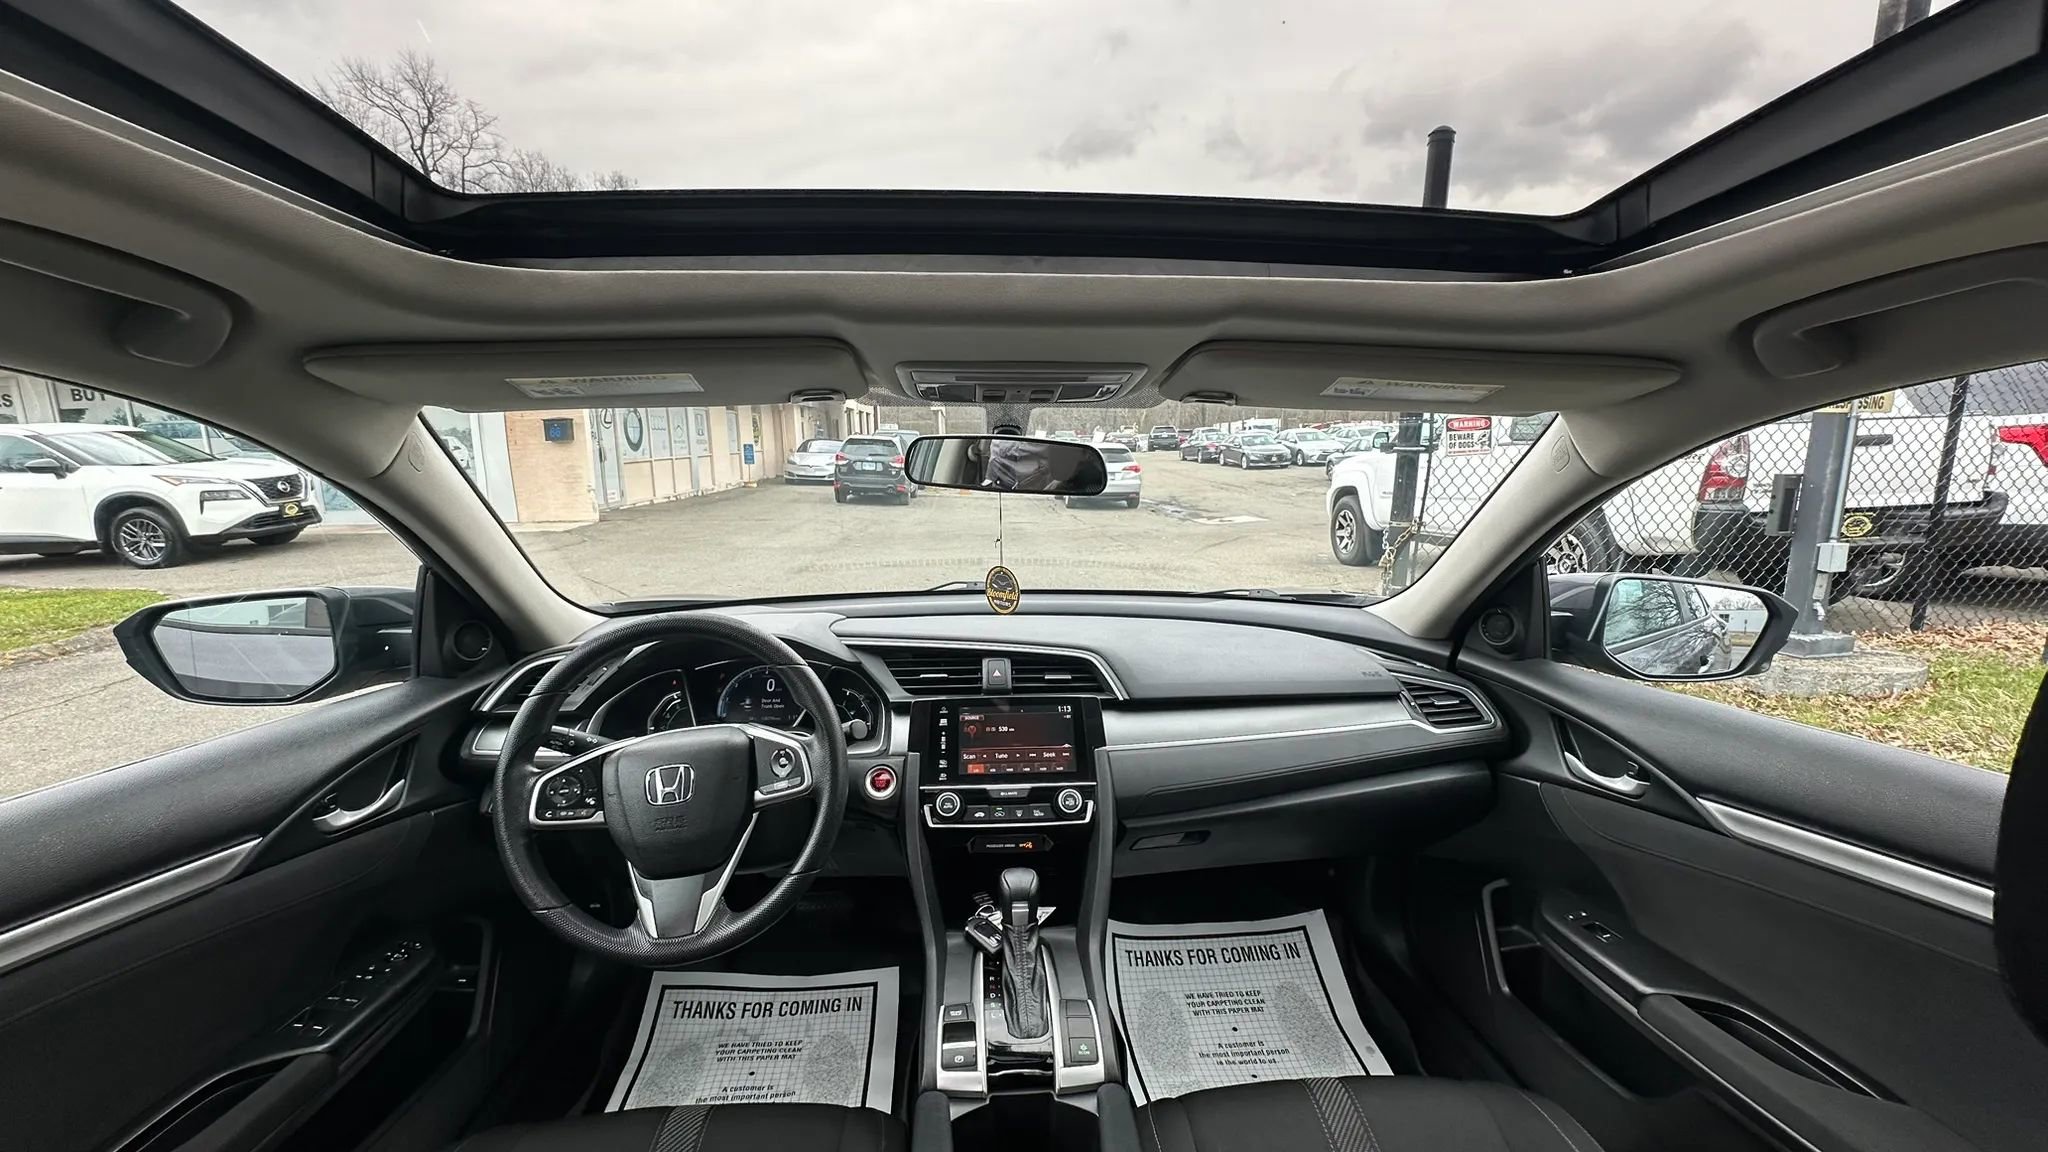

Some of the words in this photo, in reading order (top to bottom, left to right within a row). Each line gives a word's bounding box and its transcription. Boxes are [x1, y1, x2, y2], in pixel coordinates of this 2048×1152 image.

[1449, 433, 1474, 441] BEWARE
[766, 678, 775, 691] 0
[1125, 949, 1184, 967] THANKS
[1187, 948, 1218, 965] FOR
[1221, 943, 1281, 964] COMING
[1284, 942, 1301, 959] IN
[1196, 991, 1214, 999] HAVE
[1206, 999, 1243, 1007] CARPETING
[673, 1001, 736, 1019] THANKS
[741, 1001, 773, 1019] FOR
[779, 998, 841, 1017] COMING
[846, 997, 862, 1012] IN
[1228, 1007, 1250, 1015] PAPER
[1225, 1041, 1256, 1049] customer
[737, 1047, 777, 1055] CARPETING
[1212, 1050, 1230, 1058] most
[1231, 1049, 1265, 1058] important
[1266, 1048, 1290, 1056] person
[731, 1093, 768, 1101] important
[769, 1091, 796, 1099] person
